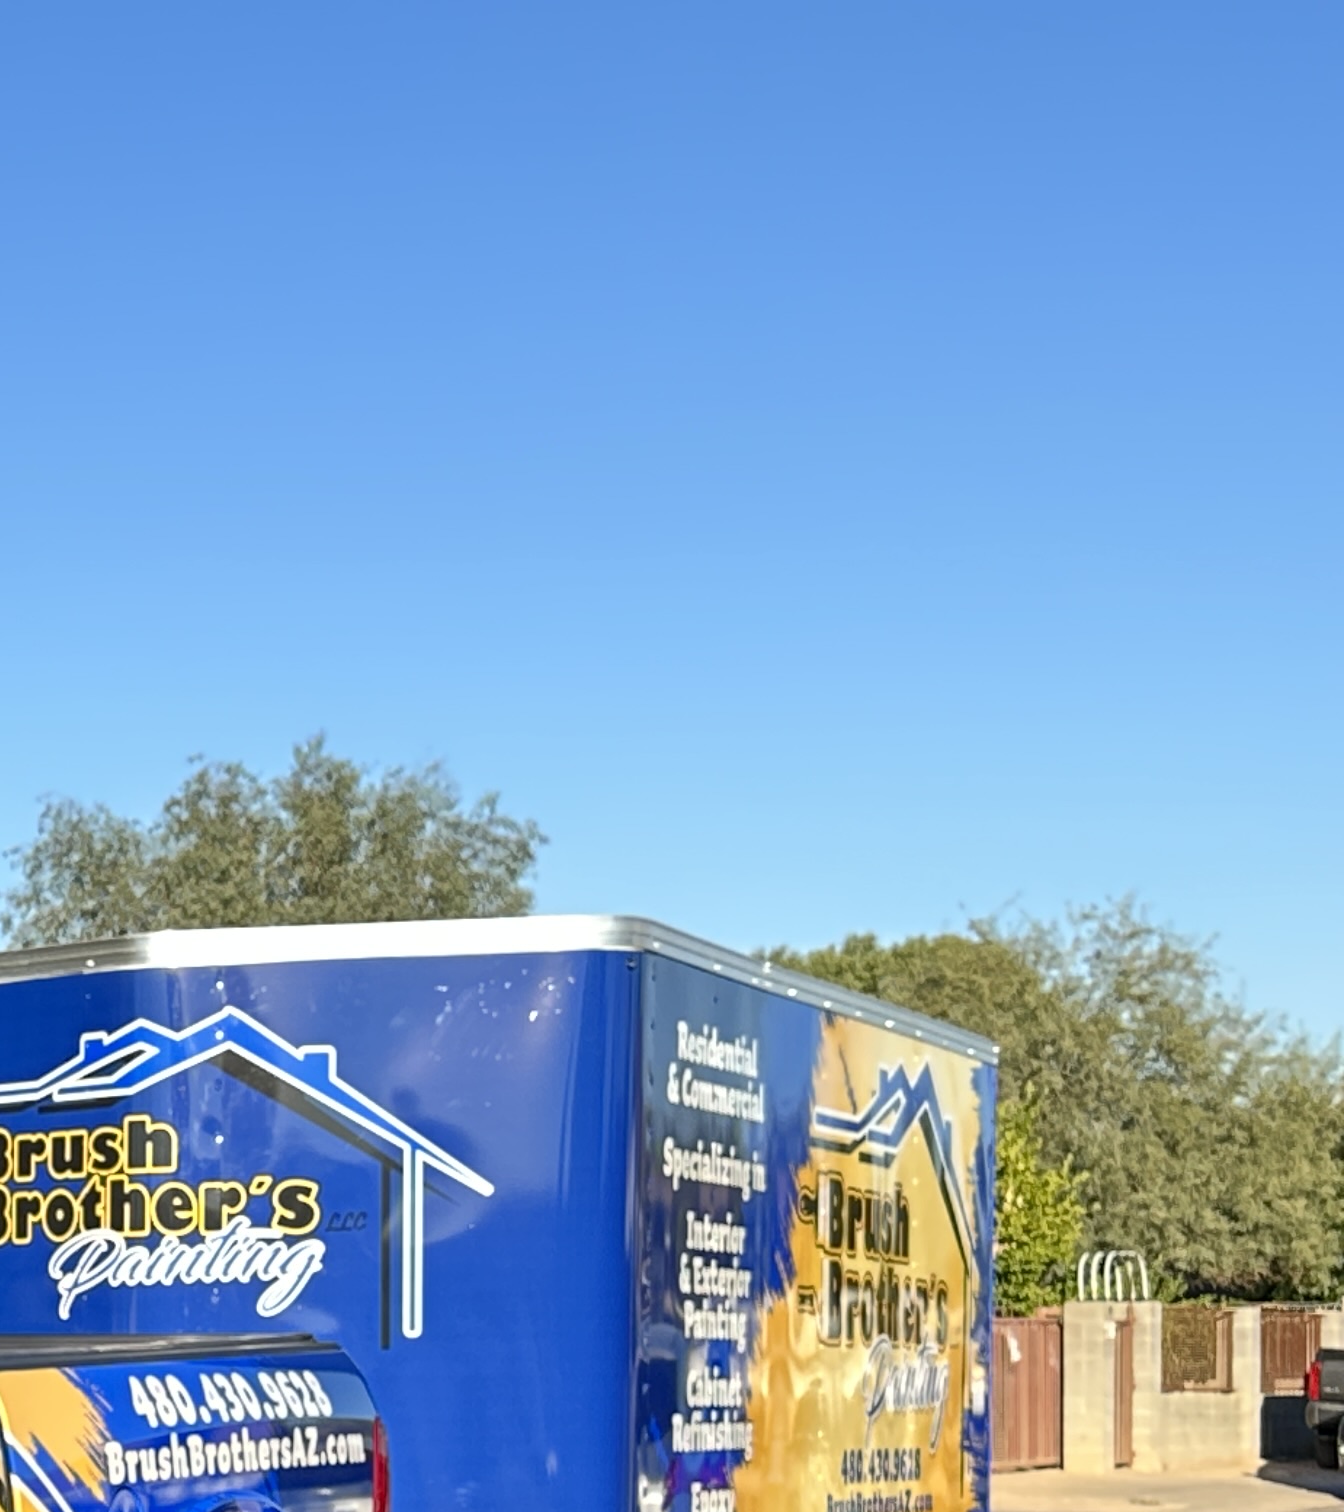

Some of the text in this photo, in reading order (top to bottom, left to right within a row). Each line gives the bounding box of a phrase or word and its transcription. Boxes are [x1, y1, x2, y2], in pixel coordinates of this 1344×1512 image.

[677, 1020, 758, 1078] Residential
[667, 1062, 764, 1123] & Commercial
[663, 1137, 767, 1200] Specializing in
[325, 1211, 368, 1232] LLC
[686, 1210, 746, 1255] Interior
[829, 1174, 911, 1266] Brush
[48, 1216, 326, 1320] Painting
[679, 1252, 751, 1298] & Exterior
[684, 1299, 746, 1353] Painting
[826, 1258, 950, 1352] Brother's
[128, 1370, 333, 1428] 480.430.9628
[687, 1365, 742, 1407] Cabinet
[105, 1426, 366, 1485] BrushBrothersAZ.com
[672, 1410, 753, 1461] Refinishing
